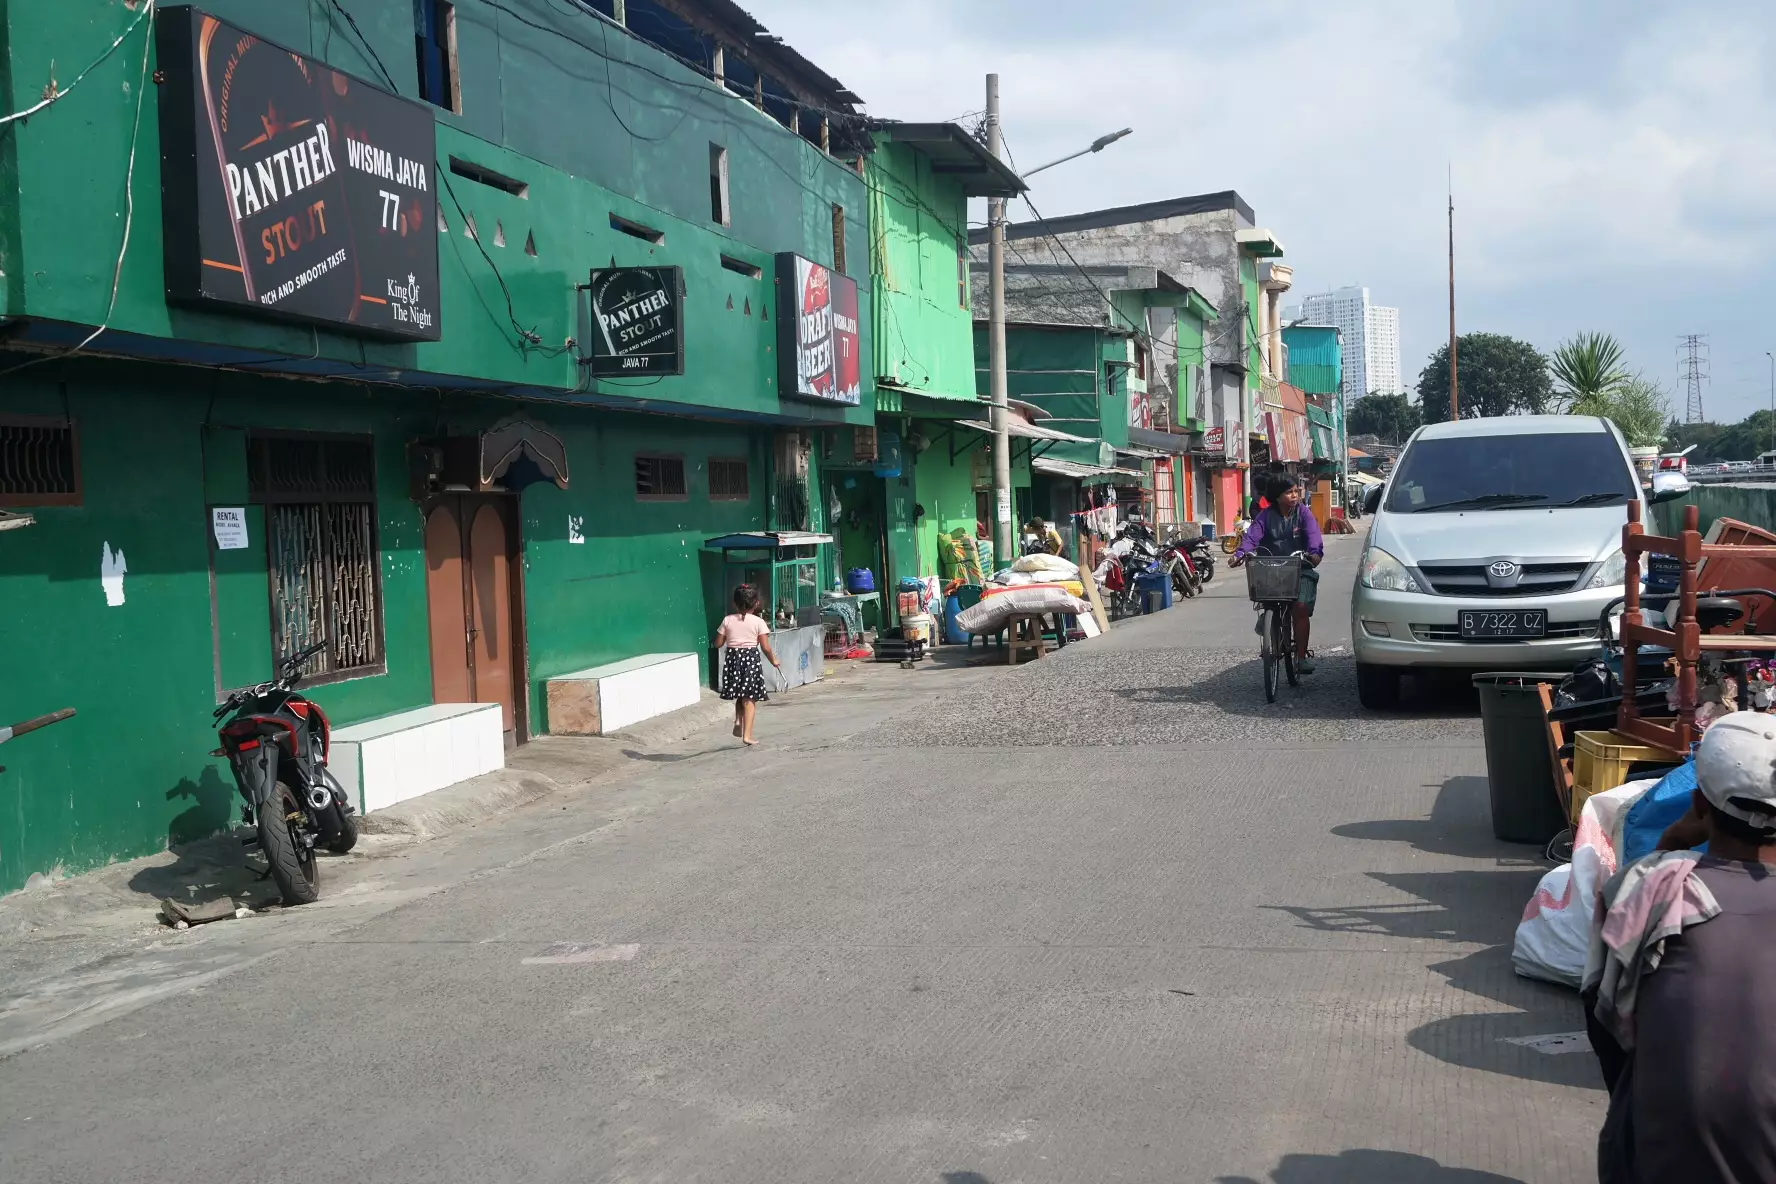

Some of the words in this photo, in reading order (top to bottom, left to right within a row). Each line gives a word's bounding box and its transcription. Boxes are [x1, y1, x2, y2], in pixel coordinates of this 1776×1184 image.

[221, 53, 239, 133] ORIGINAL
[225, 122, 336, 220] PANTHER
[347, 137, 394, 181] WISMA
[396, 156, 427, 192] JAYA
[379, 189, 400, 231] 77
[261, 200, 326, 265] STOUT
[278, 280, 295, 300] AND
[295, 260, 328, 289] SMOOTH
[326, 248, 347, 270] TASTE
[387, 278, 408, 304] King
[408, 282, 420, 303] Of
[391, 302, 408, 322] The
[409, 305, 432, 329] Night
[600, 289, 669, 332] PANTHER
[620, 314, 662, 342] STOUT
[802, 304, 831, 344] DRAFT
[629, 343, 640, 352] AND
[640, 333, 662, 347] SMOOTH
[804, 338, 831, 378] BEER
[622, 357, 640, 369] JAVA
[640, 357, 649, 368] 77
[217, 511, 238, 521] RENTAL
[1464, 613, 1474, 629] B
[1480, 613, 1517, 629] 7322
[1524, 613, 1542, 629] CZ
